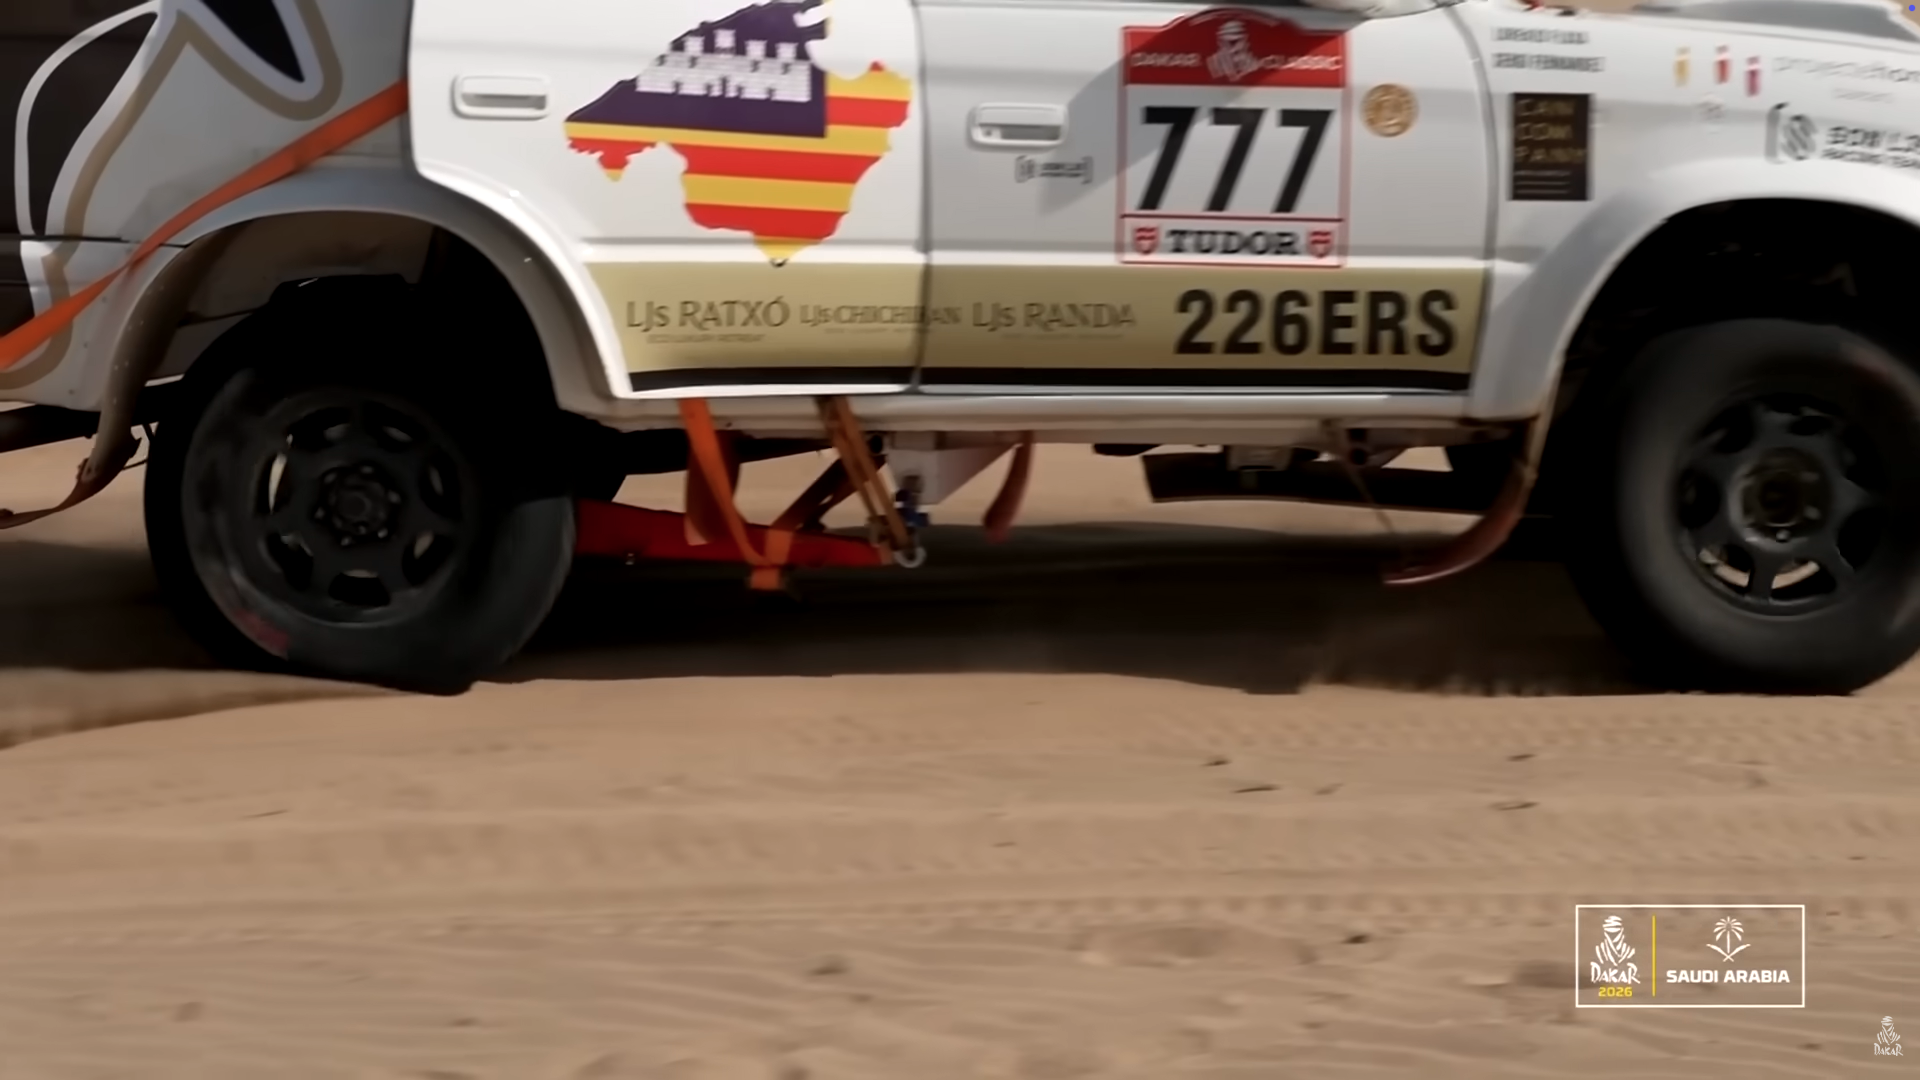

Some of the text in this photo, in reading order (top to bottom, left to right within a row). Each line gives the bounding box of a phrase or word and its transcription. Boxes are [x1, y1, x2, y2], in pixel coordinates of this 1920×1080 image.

[1136, 105, 1335, 214] 777
[1165, 229, 1301, 255] TUDOR
[678, 295, 791, 331] RATXÓ
[1023, 302, 1138, 332] RANDA
[1173, 288, 1458, 357] 226ERS
